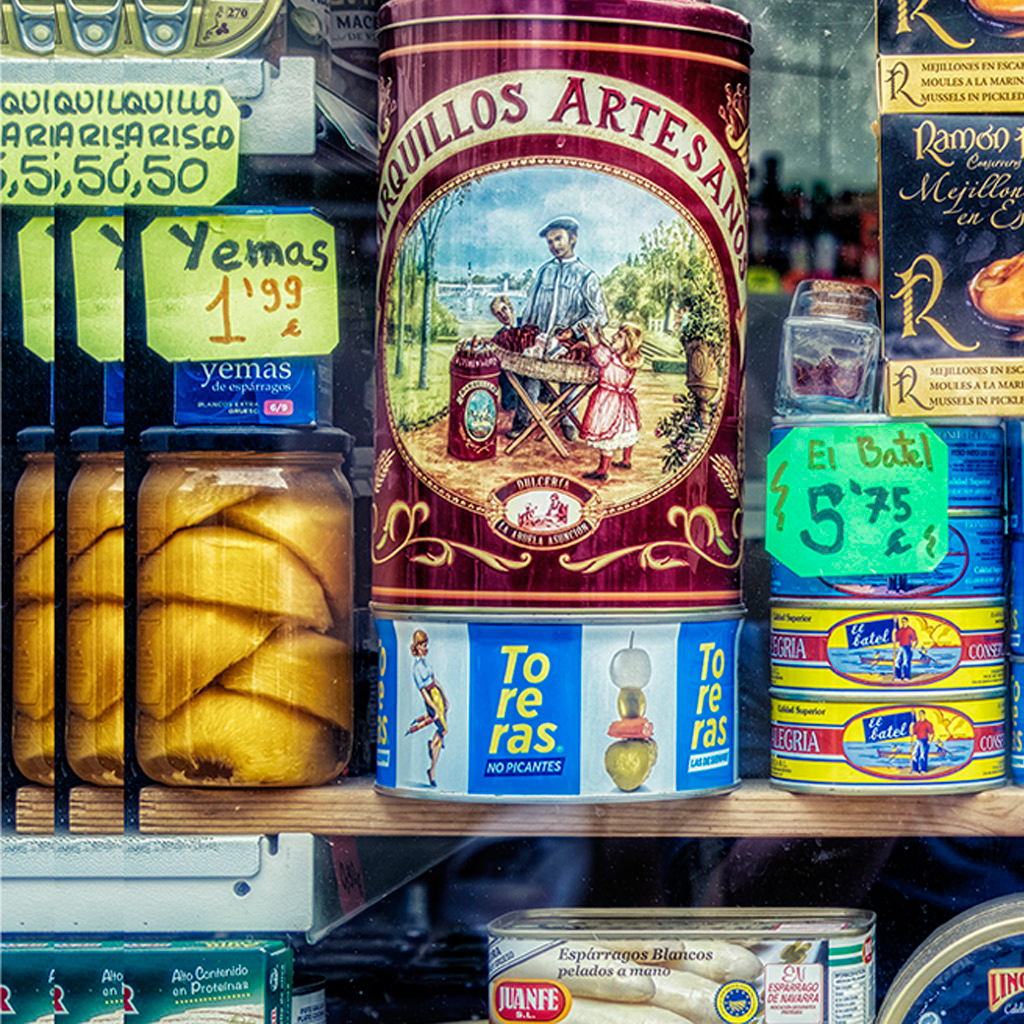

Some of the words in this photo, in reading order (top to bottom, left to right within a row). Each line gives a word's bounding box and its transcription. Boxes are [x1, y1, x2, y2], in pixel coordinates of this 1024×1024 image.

[921, 62, 980, 73] MEJILLONES
[981, 62, 995, 71] EN
[378, 82, 528, 240] RQUILLOS
[168, 220, 329, 272] Yemas
[201, 361, 292, 388] yemas
[211, 381, 230, 393] de
[231, 378, 292, 394] espárragos
[269, 403, 288, 412] 6/9
[786, 614, 812, 624] Superior
[500, 644, 551, 684] To
[699, 642, 725, 681] To
[496, 685, 543, 719] re
[696, 683, 722, 715] re
[486, 761, 505, 775] NO
[506, 759, 562, 774] PICANTES
[558, 947, 649, 964] Espárragos
[651, 947, 714, 962] Blancos
[171, 967, 196, 984] Alto
[196, 964, 249, 982] Contenido
[557, 965, 614, 979] pelados
[616, 968, 626, 977] a
[628, 967, 671, 977] mano
[173, 985, 188, 996] en
[191, 980, 249, 994] Proteínas
[499, 987, 558, 1012] JUANFE
